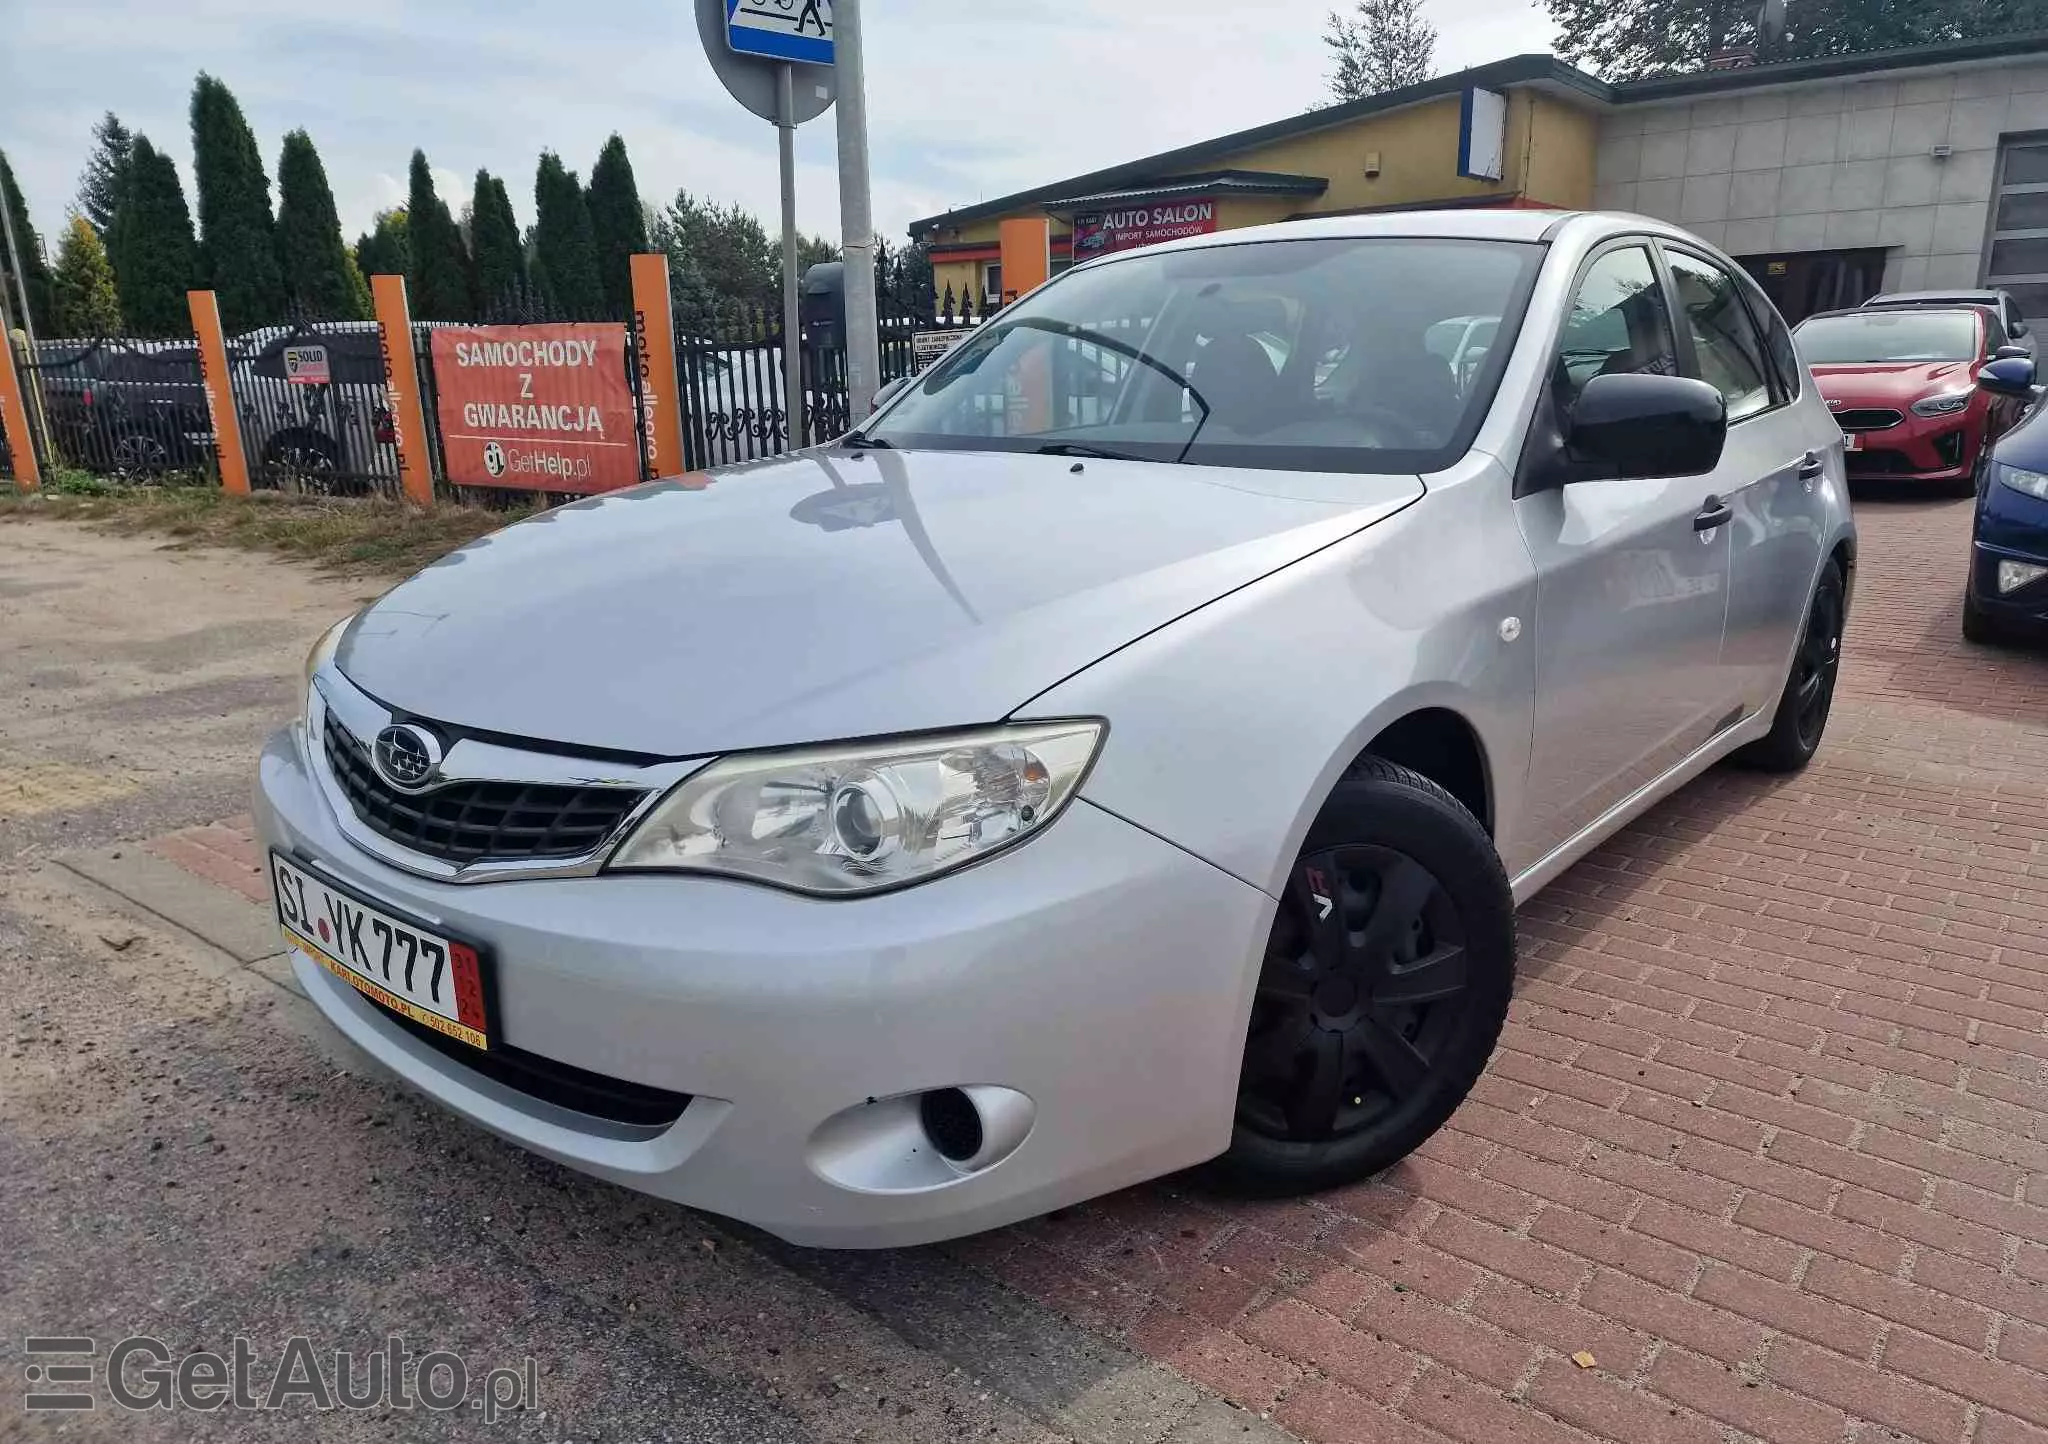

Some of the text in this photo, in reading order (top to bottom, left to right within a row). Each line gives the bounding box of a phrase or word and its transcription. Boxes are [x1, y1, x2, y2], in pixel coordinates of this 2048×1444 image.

[1103, 210, 1148, 230] AUTO
[1153, 203, 1212, 225] SALON
[1115, 231, 1142, 241] IMPORT
[298, 350, 322, 362] SOLID
[456, 340, 597, 367] SAMOCHODY
[519, 374, 534, 398] Z
[464, 403, 605, 439] GWARANCJĄ
[507, 448, 592, 481] GetHelp.pl
[279, 866, 314, 935] SI
